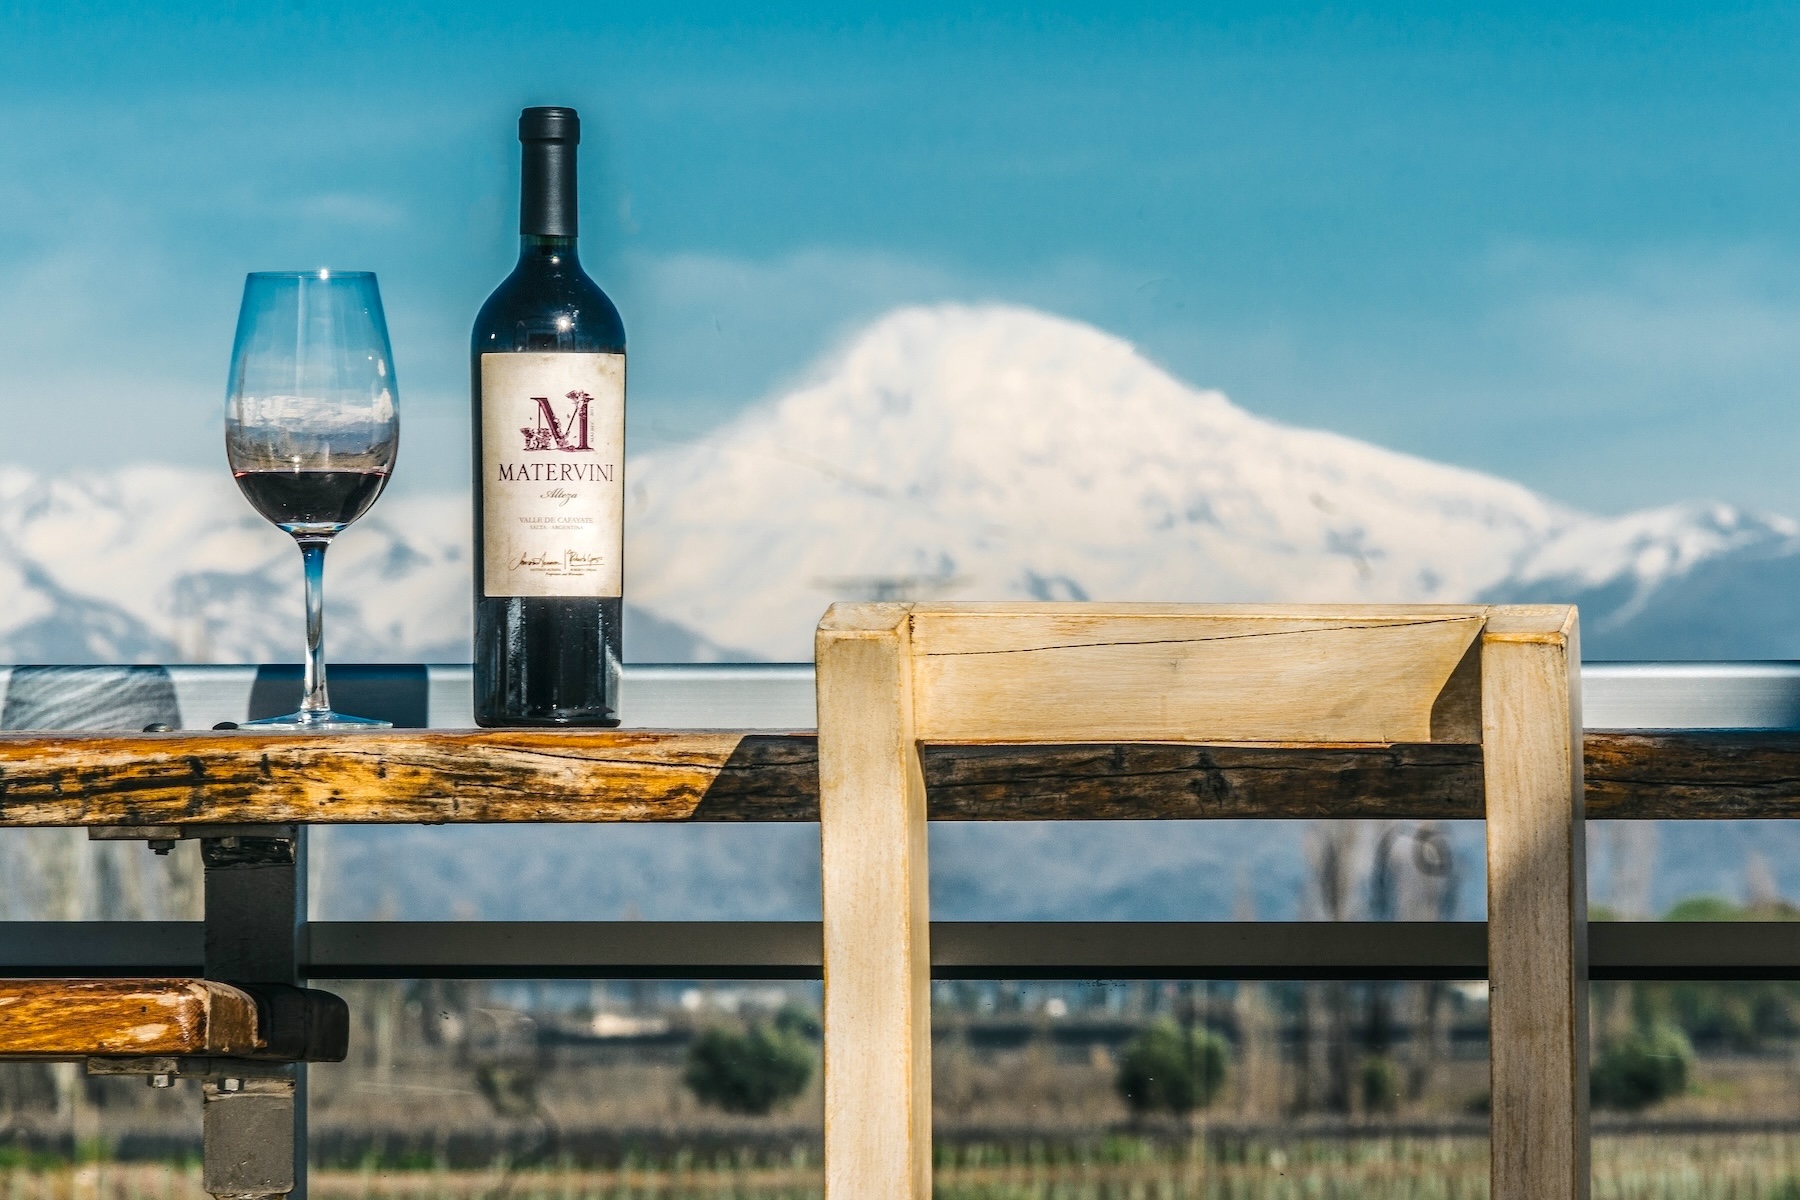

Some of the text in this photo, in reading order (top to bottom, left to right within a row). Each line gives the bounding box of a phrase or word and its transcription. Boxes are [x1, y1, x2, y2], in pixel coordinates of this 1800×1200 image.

[527, 396, 595, 451] M
[498, 463, 614, 482] MATERVINI
[540, 487, 578, 507] Alteza
